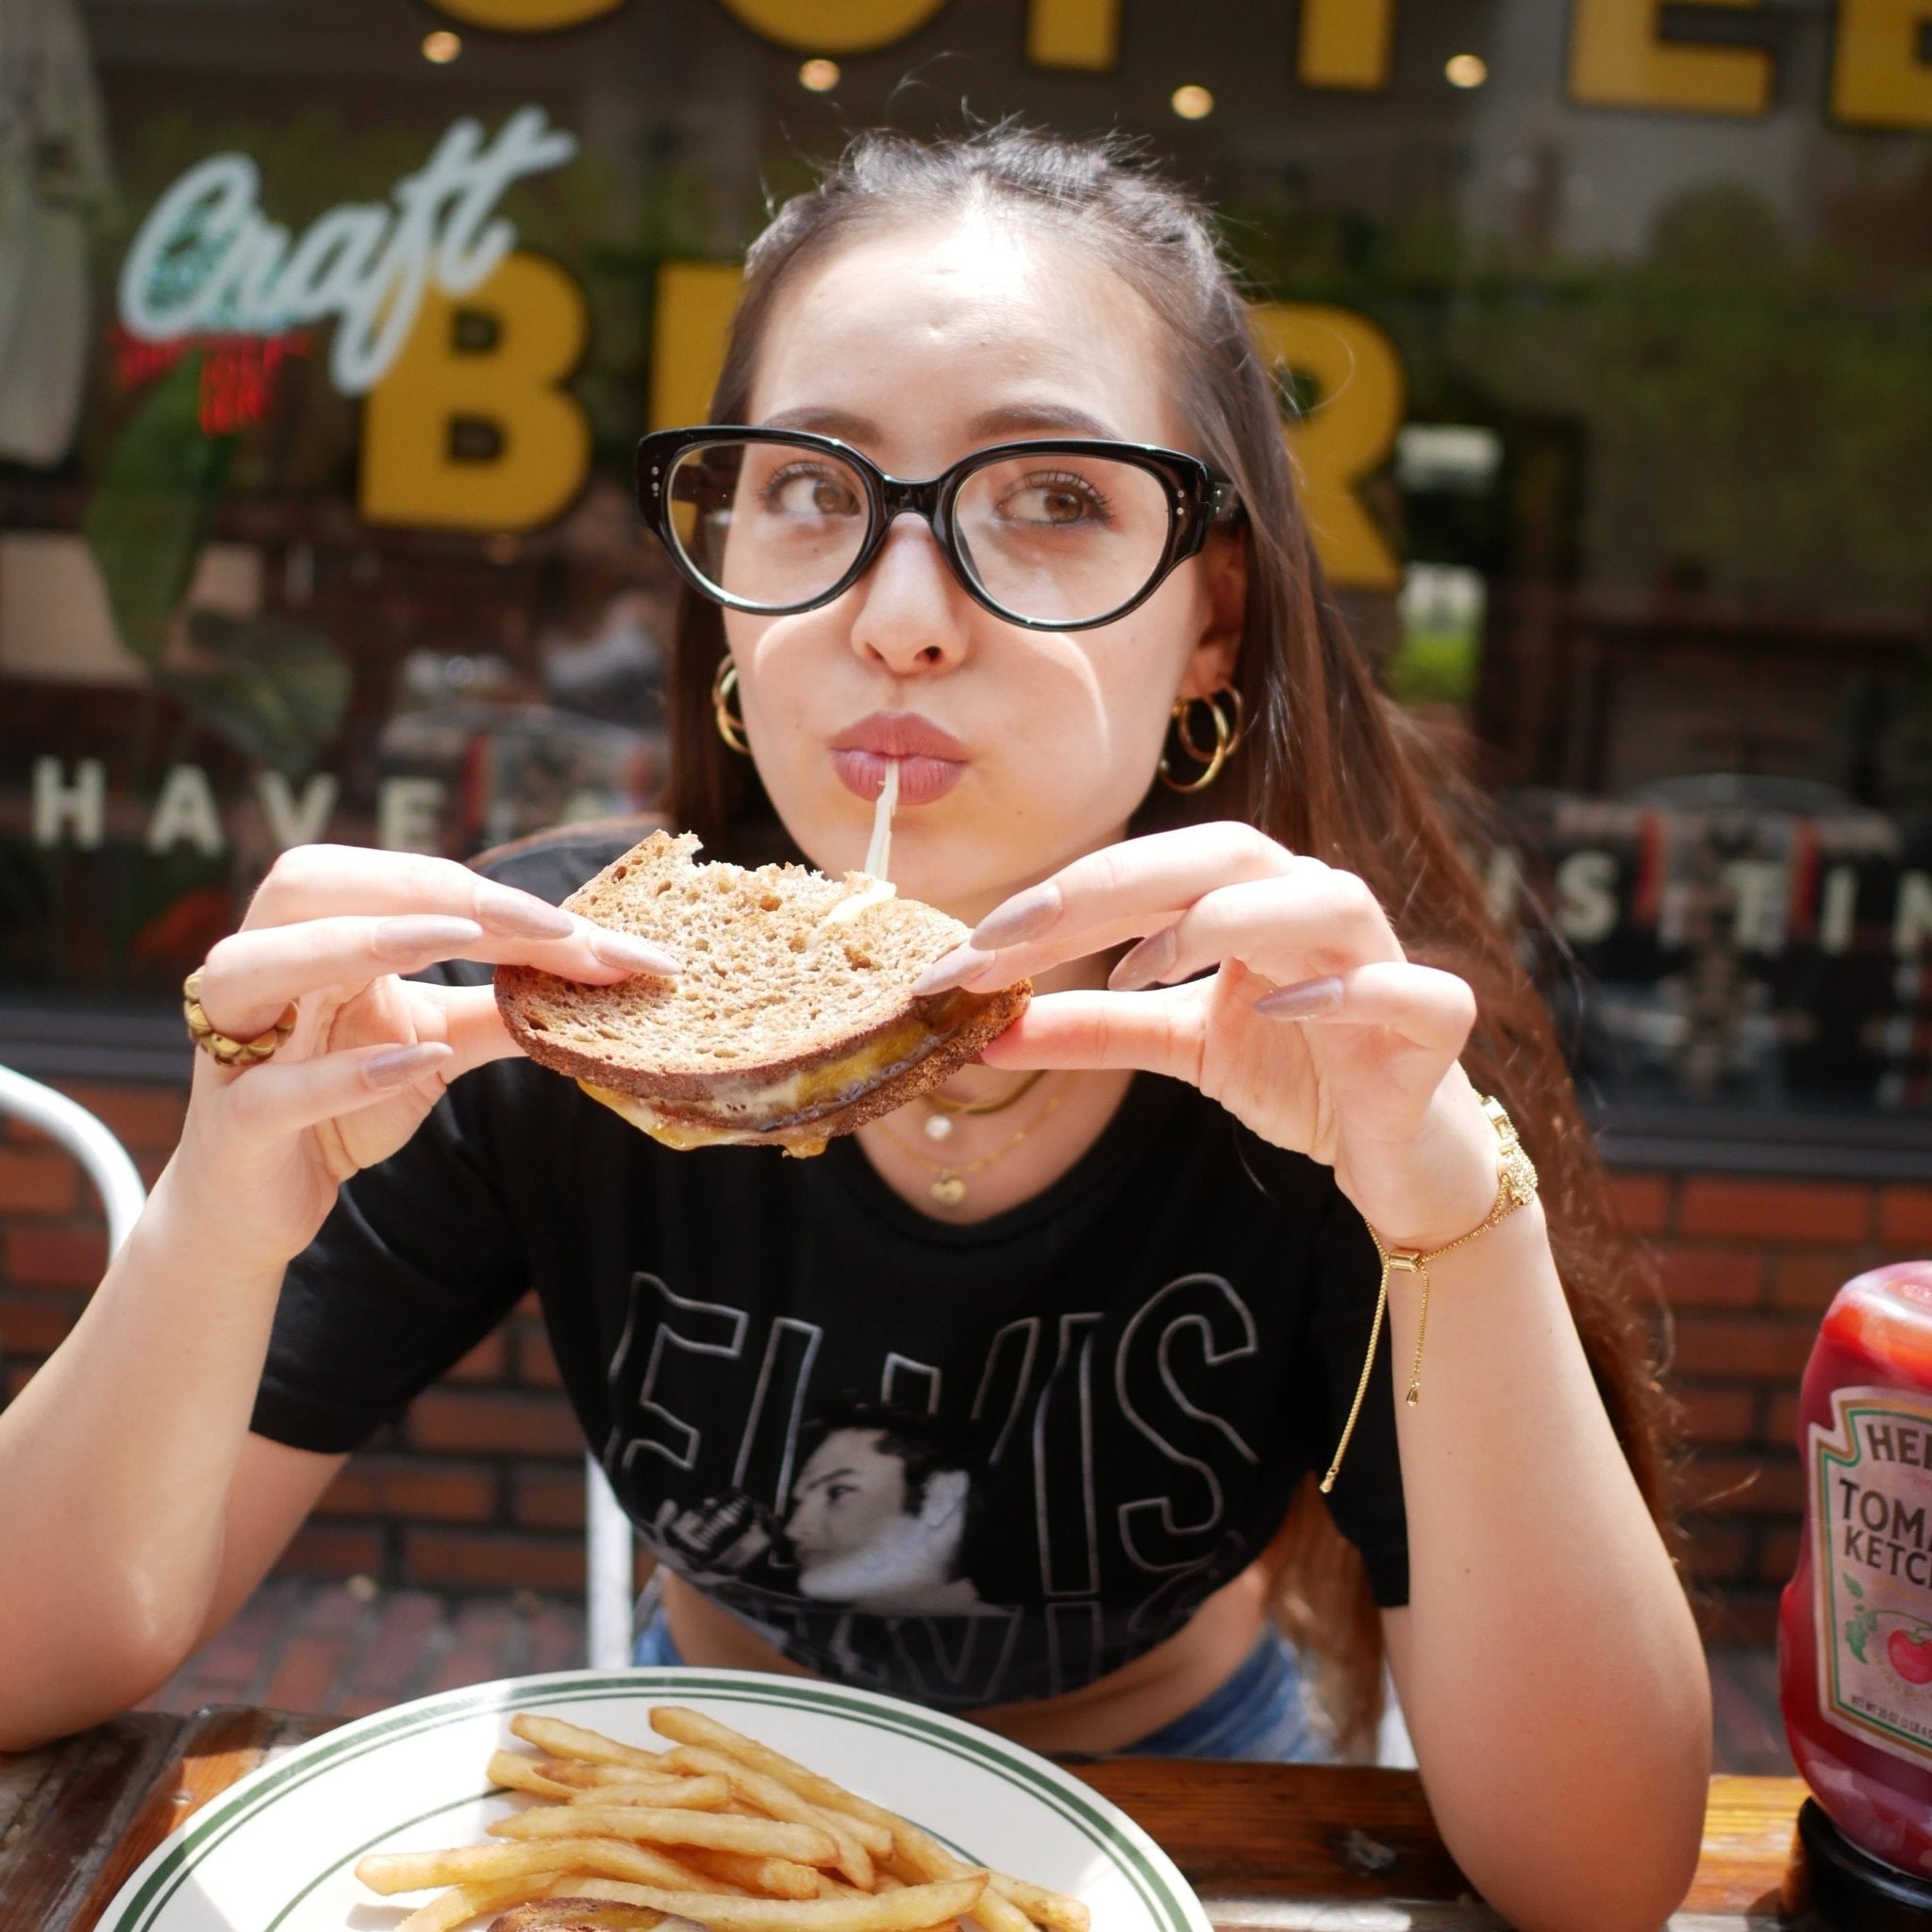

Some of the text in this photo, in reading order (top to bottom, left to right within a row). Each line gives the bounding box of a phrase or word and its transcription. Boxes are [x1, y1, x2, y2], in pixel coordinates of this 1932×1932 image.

[119, 104, 576, 396] Craft
[358, 251, 1404, 591] BR
[31, 755, 447, 853] HAVE
[1839, 1477, 1932, 1554] TOM
[1844, 1525, 1932, 1591] KETC
